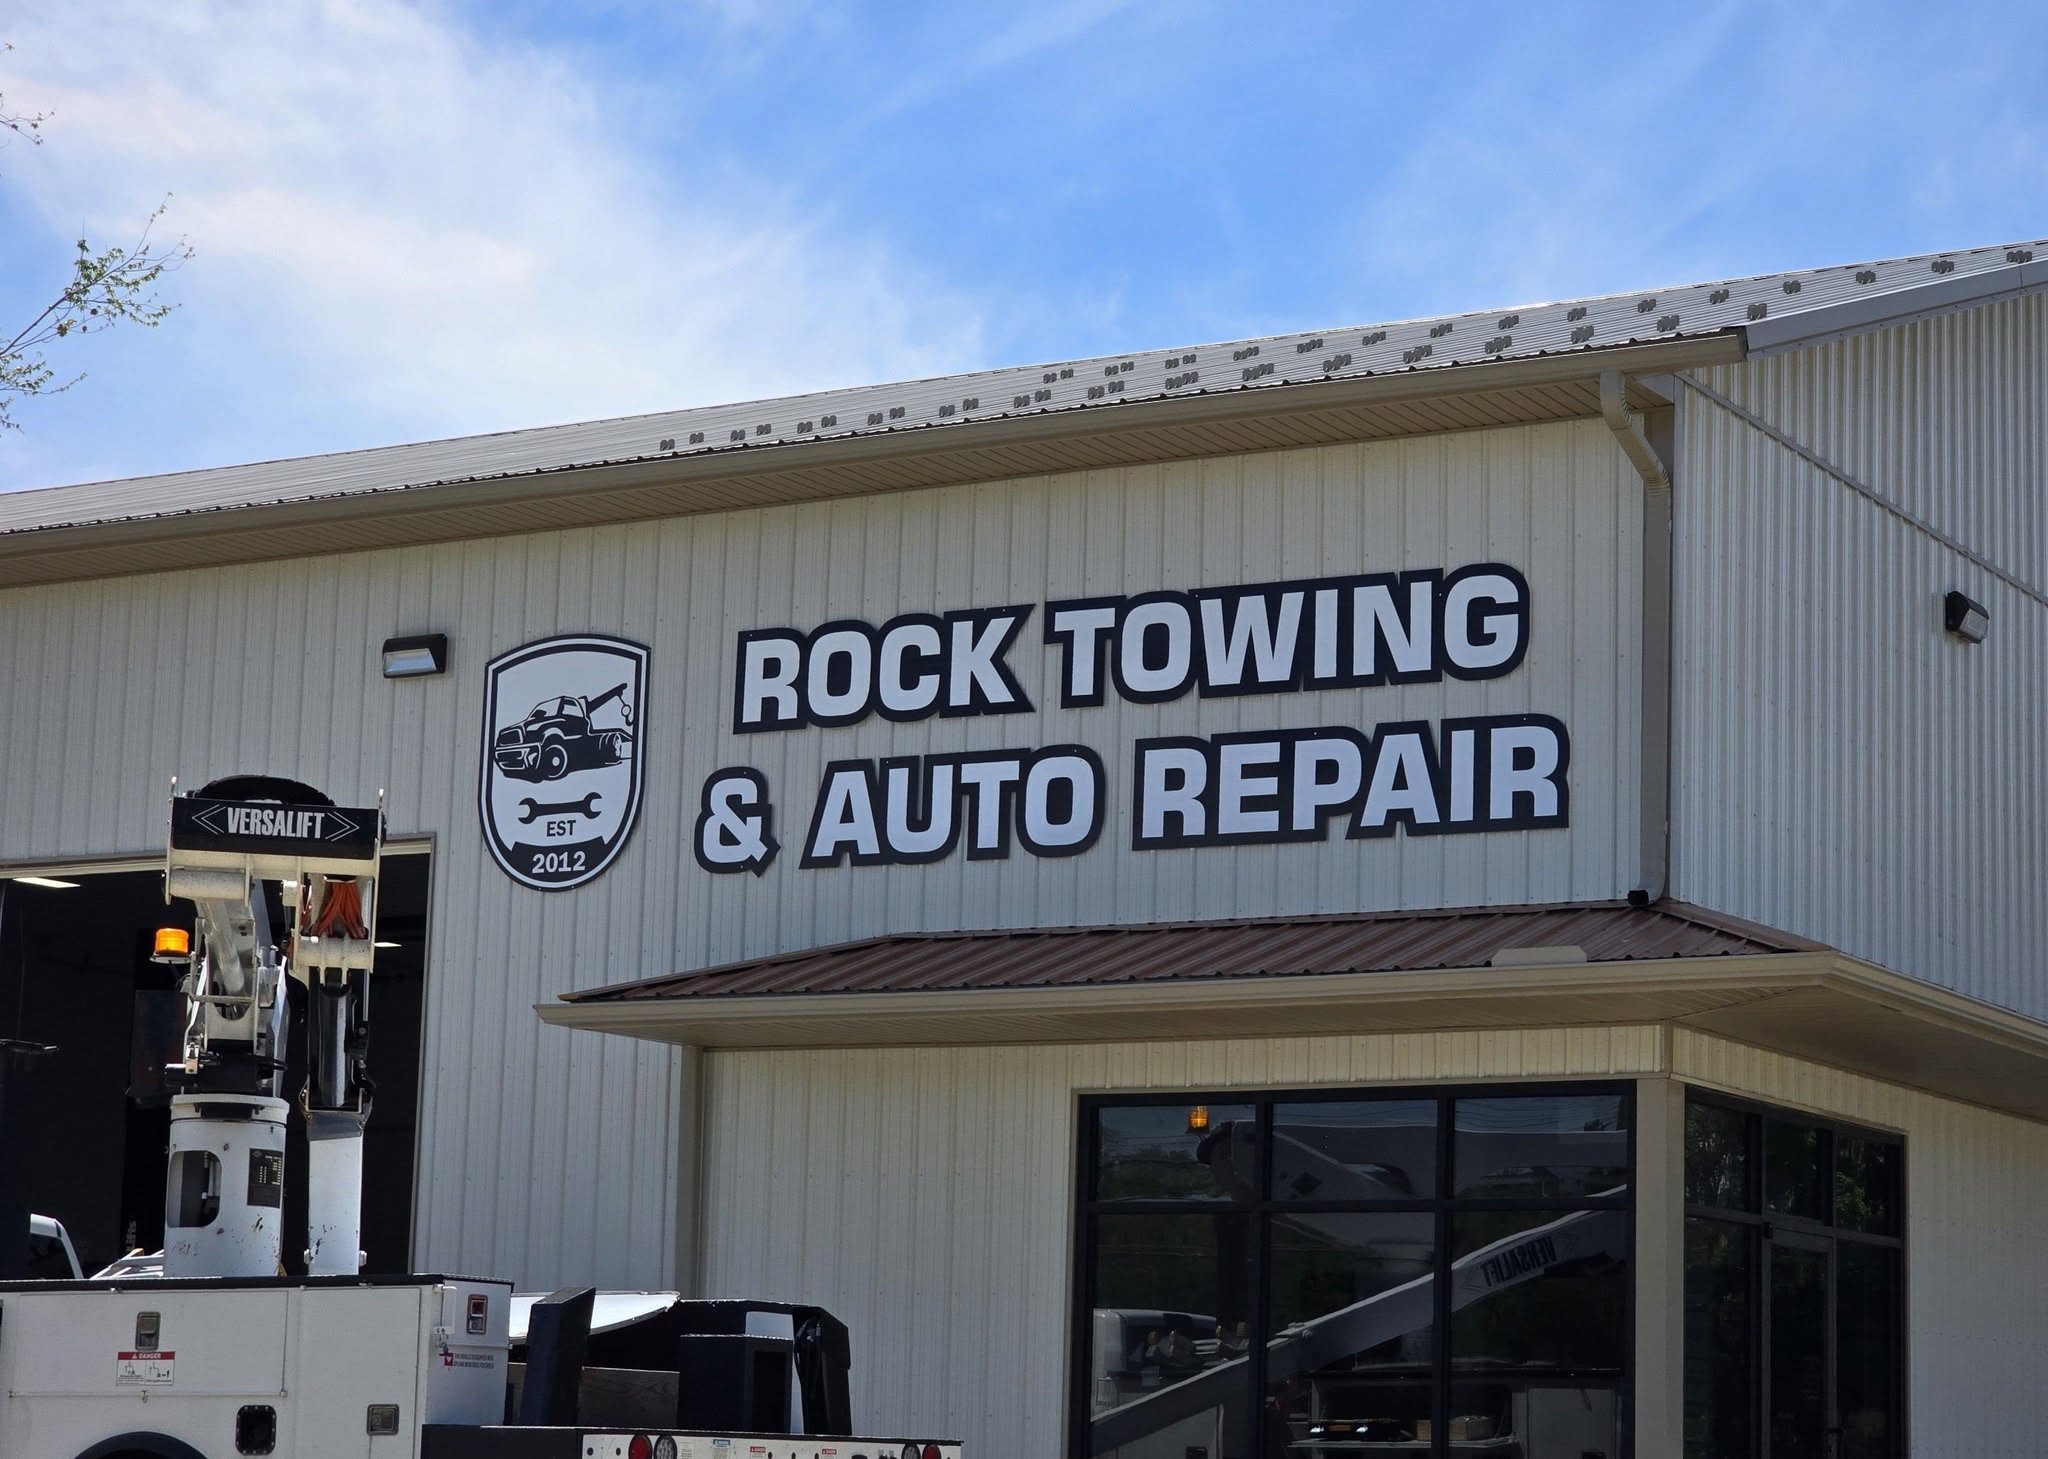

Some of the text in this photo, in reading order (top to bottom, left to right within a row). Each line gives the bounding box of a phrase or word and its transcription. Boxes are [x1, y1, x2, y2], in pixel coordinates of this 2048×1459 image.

[741, 573, 1520, 724] ROCK TOWING
[702, 724, 1560, 864] & AUTO REPAIR
[227, 807, 325, 839] VERSALIFT
[546, 819, 577, 837] EST
[531, 850, 586, 874] 2012
